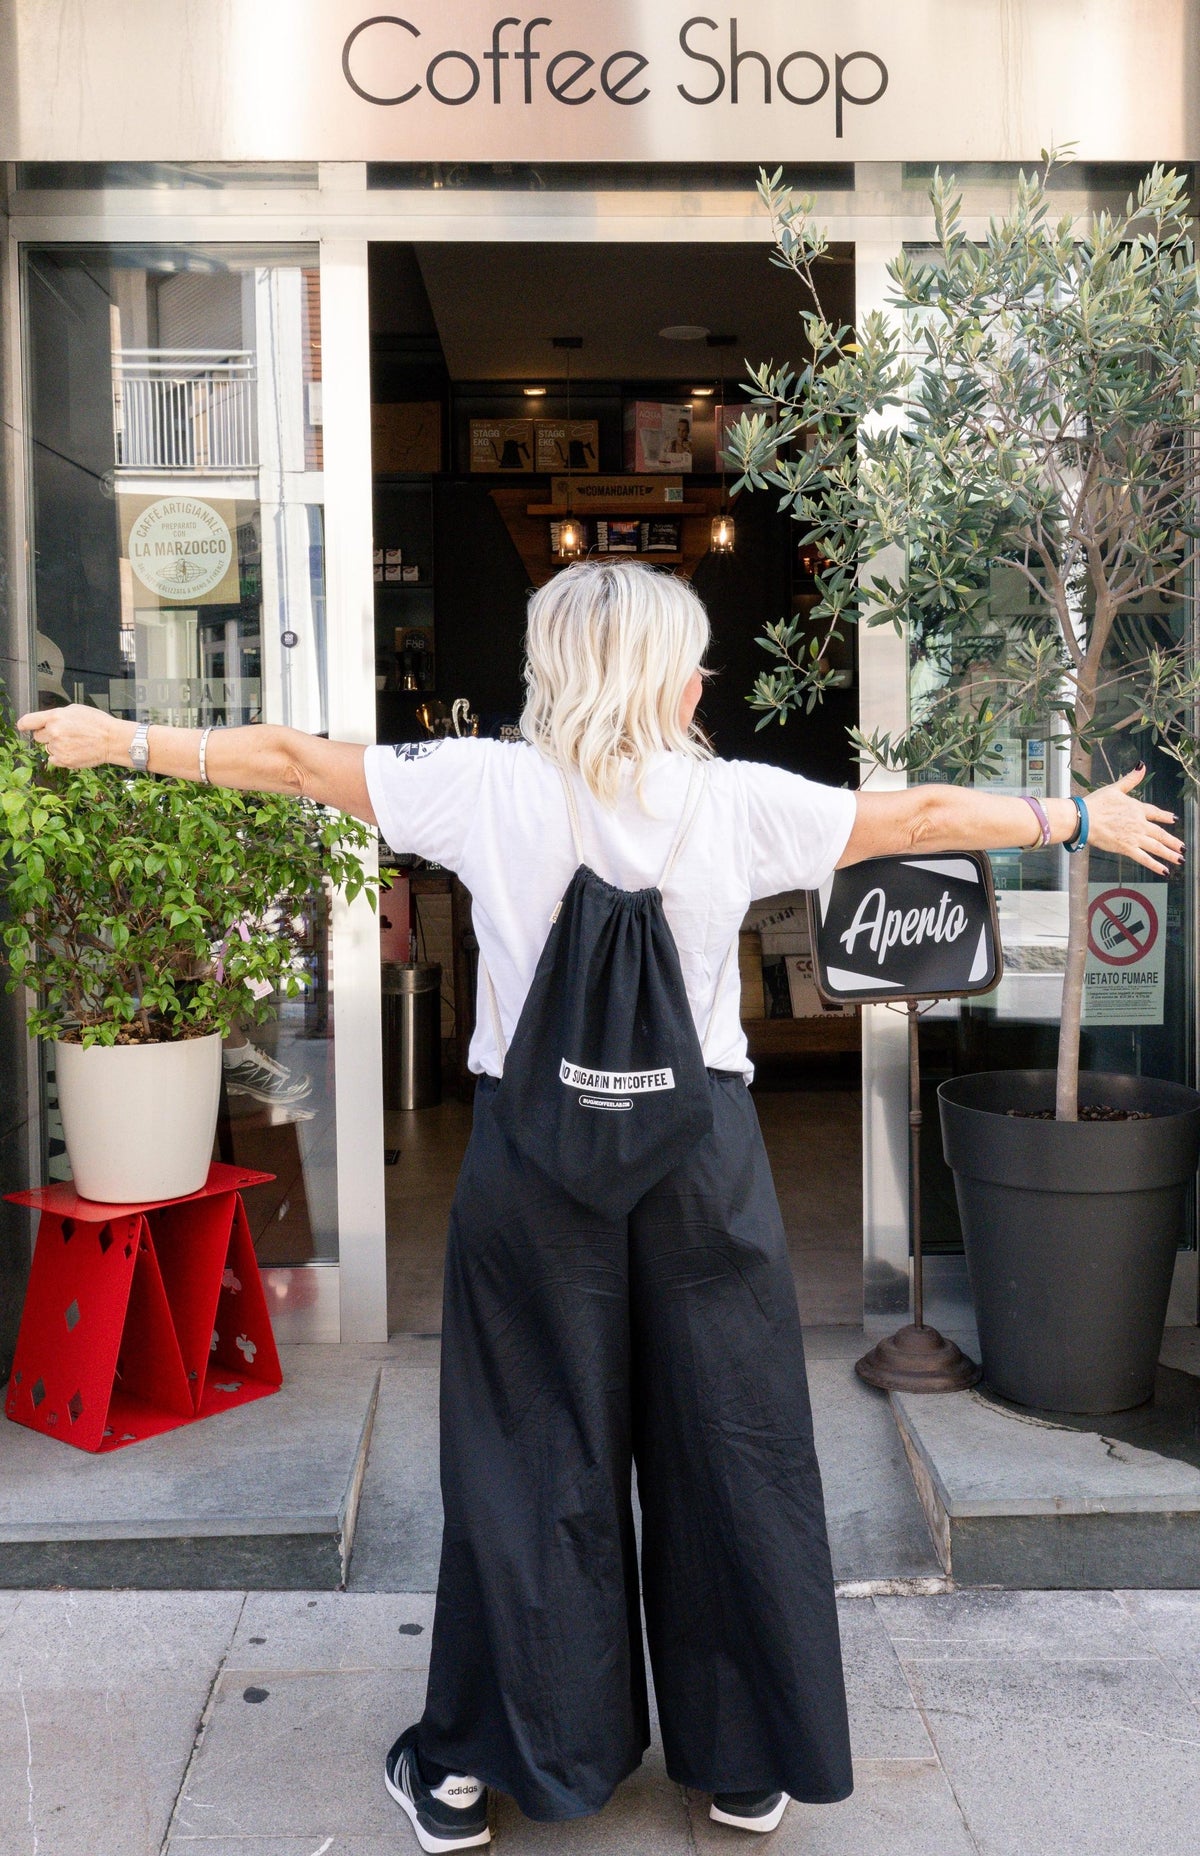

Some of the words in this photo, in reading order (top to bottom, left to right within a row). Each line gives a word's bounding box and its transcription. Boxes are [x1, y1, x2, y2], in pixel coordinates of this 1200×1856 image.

[341, 15, 652, 106] Coffee
[676, 16, 889, 139] Shop
[472, 429, 500, 438] STAGG
[538, 429, 565, 438] STAGG
[472, 438, 490, 447] EKG
[538, 438, 555, 447] EKG
[586, 485, 646, 497] COMANDANTE
[162, 502, 224, 536] ARTIGIANALE
[161, 522, 197, 530] PREPARATO
[135, 543, 151, 557] LA
[155, 539, 226, 557] MARZOCCO
[136, 682, 236, 704] BUGAN
[839, 887, 969, 965] Aperto
[1121, 972, 1159, 984] FUMARE
[447, 1783, 478, 1796] adidas
